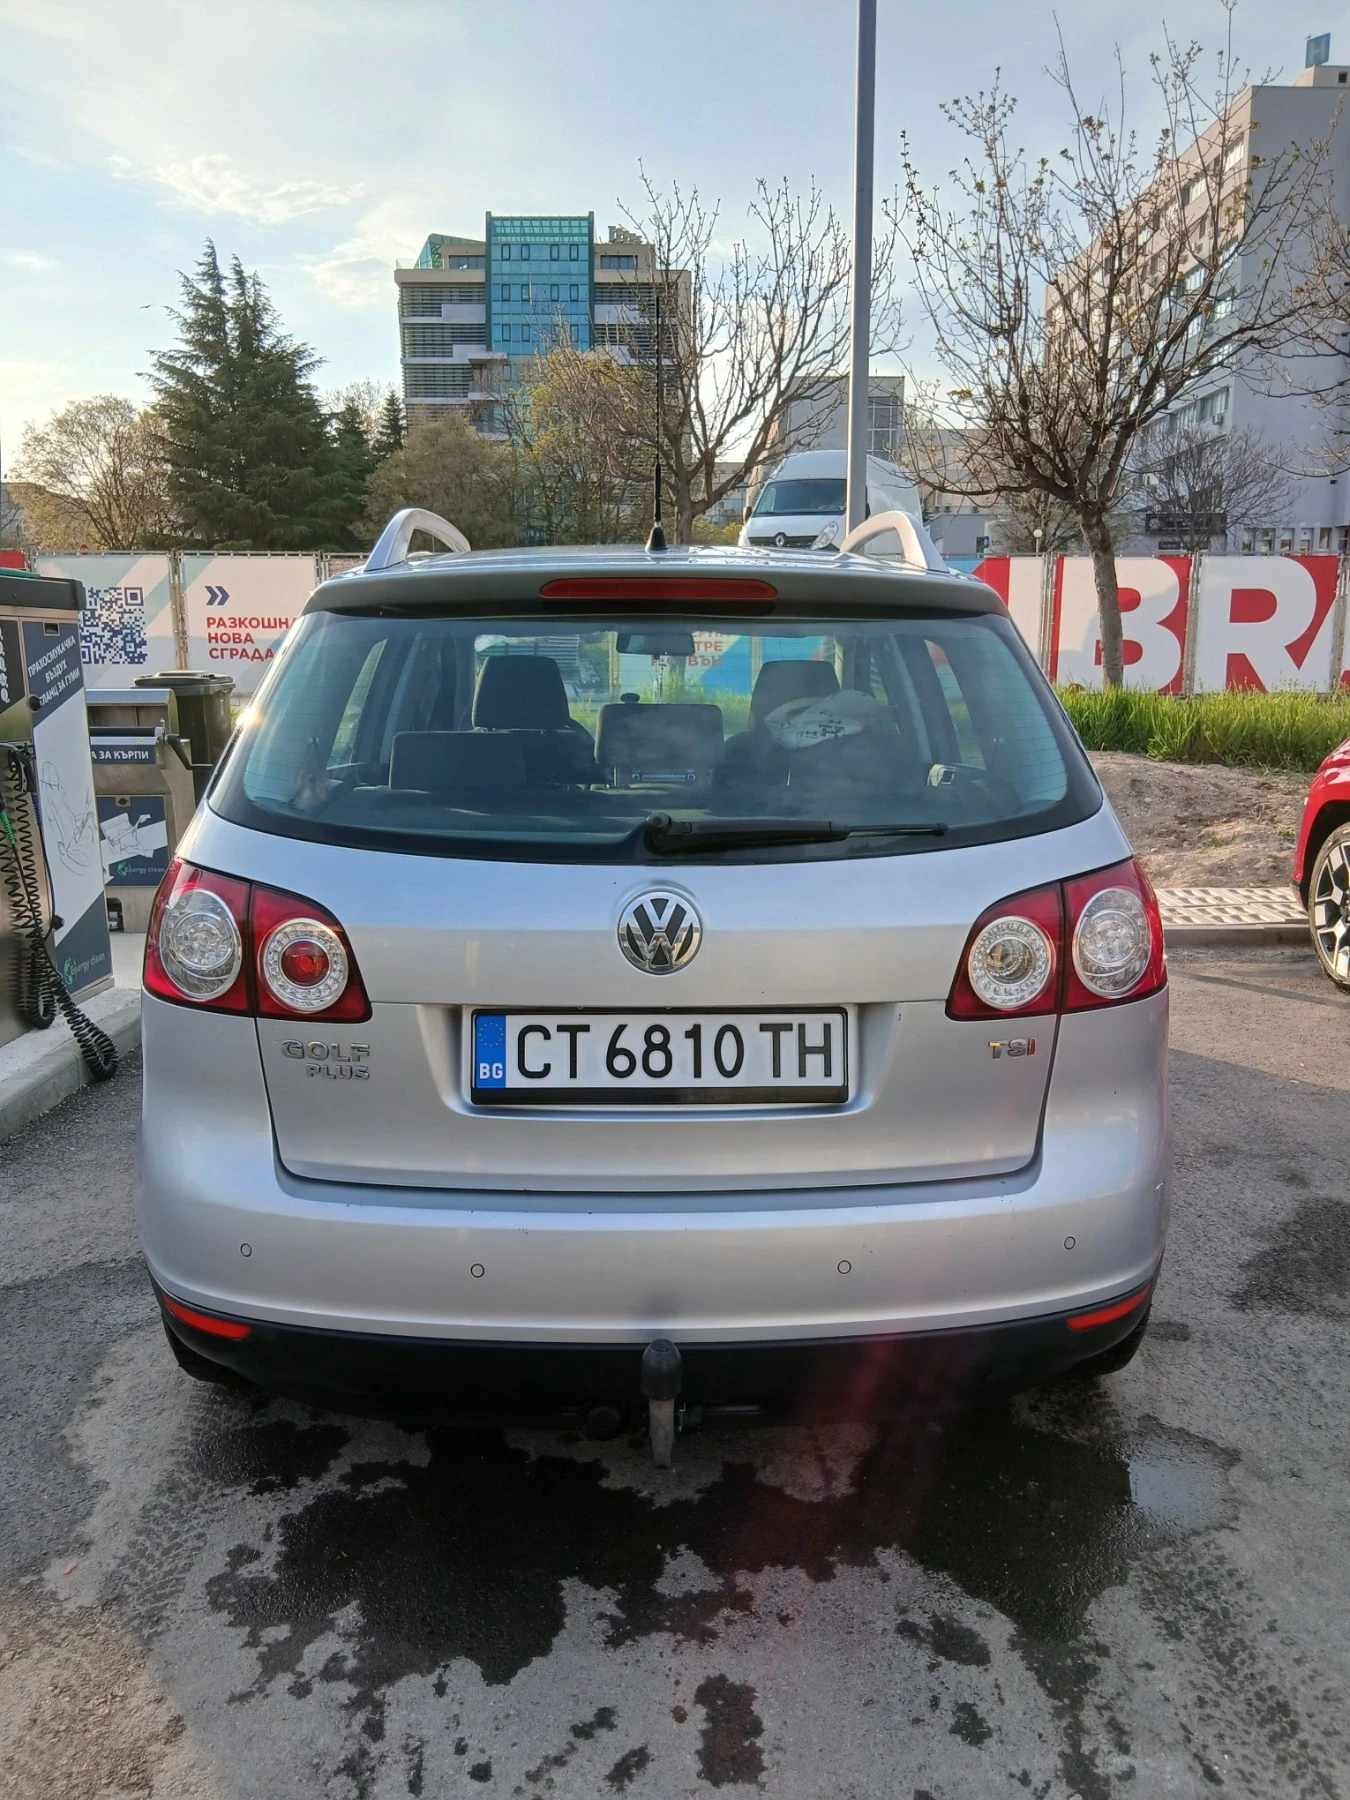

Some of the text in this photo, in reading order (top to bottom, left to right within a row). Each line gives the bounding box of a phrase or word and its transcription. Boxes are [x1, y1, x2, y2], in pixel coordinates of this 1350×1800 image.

[208, 633, 255, 644] НОВА
[28, 635, 76, 677] ПРАХОСМУКАЧКА
[209, 648, 275, 662] СГРАДА
[45, 659, 68, 683] ВЪЗДУХ
[57, 678, 66, 692] ЗА
[64, 667, 80, 686] ГУМИ
[98, 750, 112, 760] ЗА
[114, 750, 149, 760] КЪРПИ
[281, 1039, 370, 1062] GOLF
[517, 1023, 832, 1079] CT 6810 TH
[988, 1038, 1036, 1059] TSI
[305, 1063, 370, 1080] PLUS
[479, 1063, 503, 1079] BG
